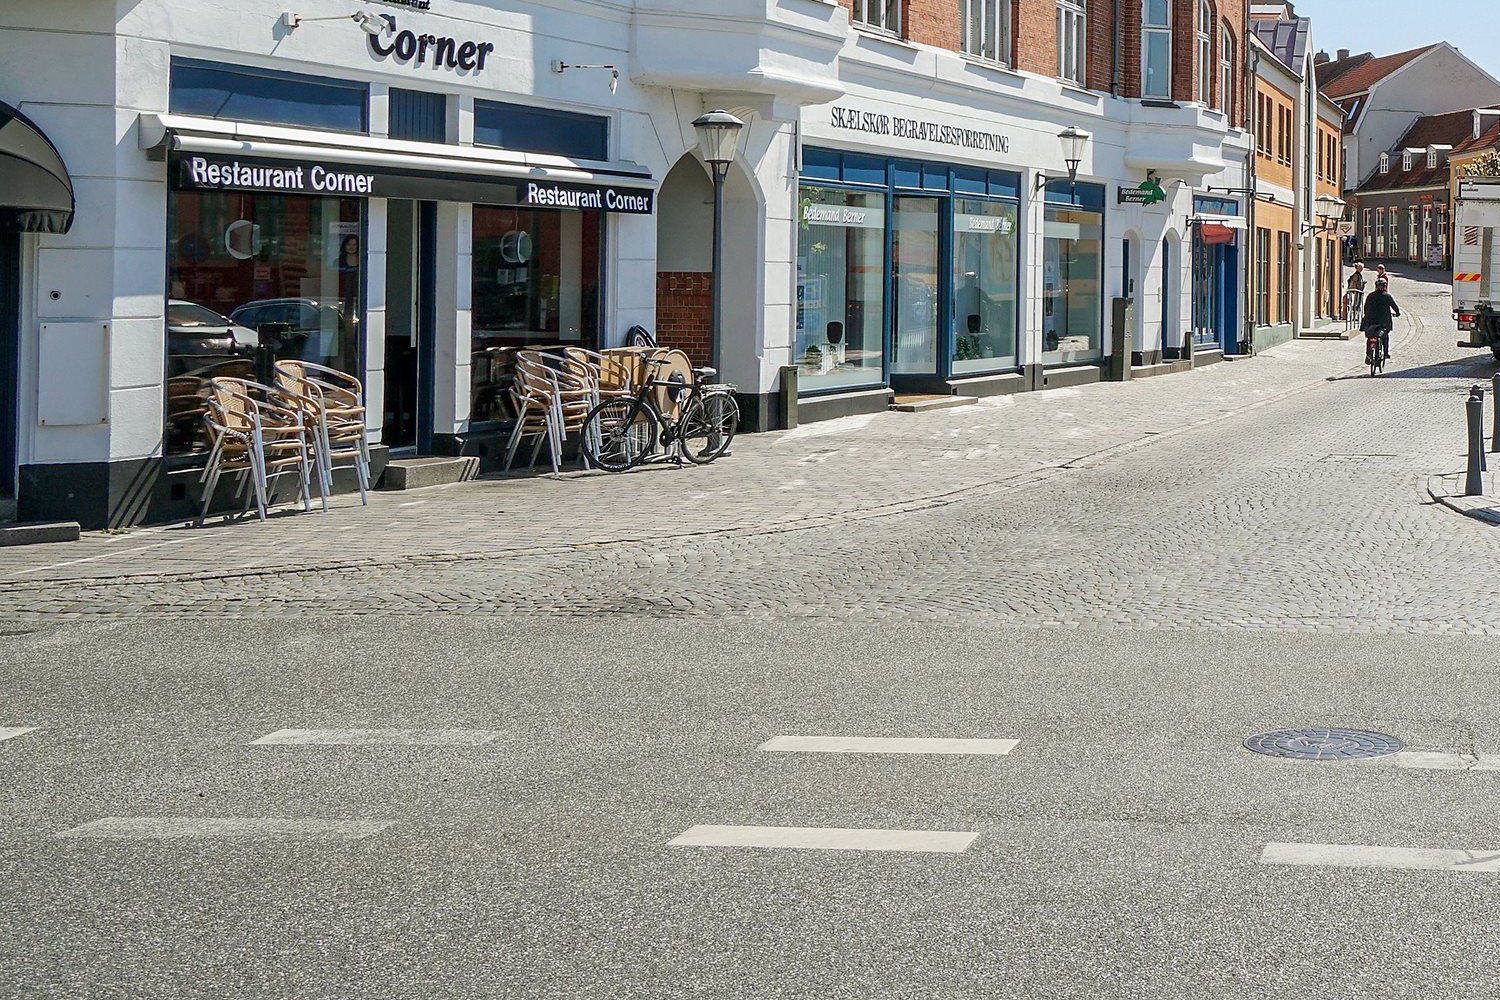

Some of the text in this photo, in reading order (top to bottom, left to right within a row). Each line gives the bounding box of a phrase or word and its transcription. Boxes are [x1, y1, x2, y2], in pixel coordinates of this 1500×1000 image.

[368, 13, 495, 71] Corner
[831, 106, 1010, 154] SKÆLSKØR BEGRAVELSESFORRETNING
[192, 156, 375, 193] Restaurant Corner
[528, 182, 650, 211] Restaurant Corner
[1121, 188, 1154, 196] Bedemand
[803, 206, 866, 223] Bedemand Berner
